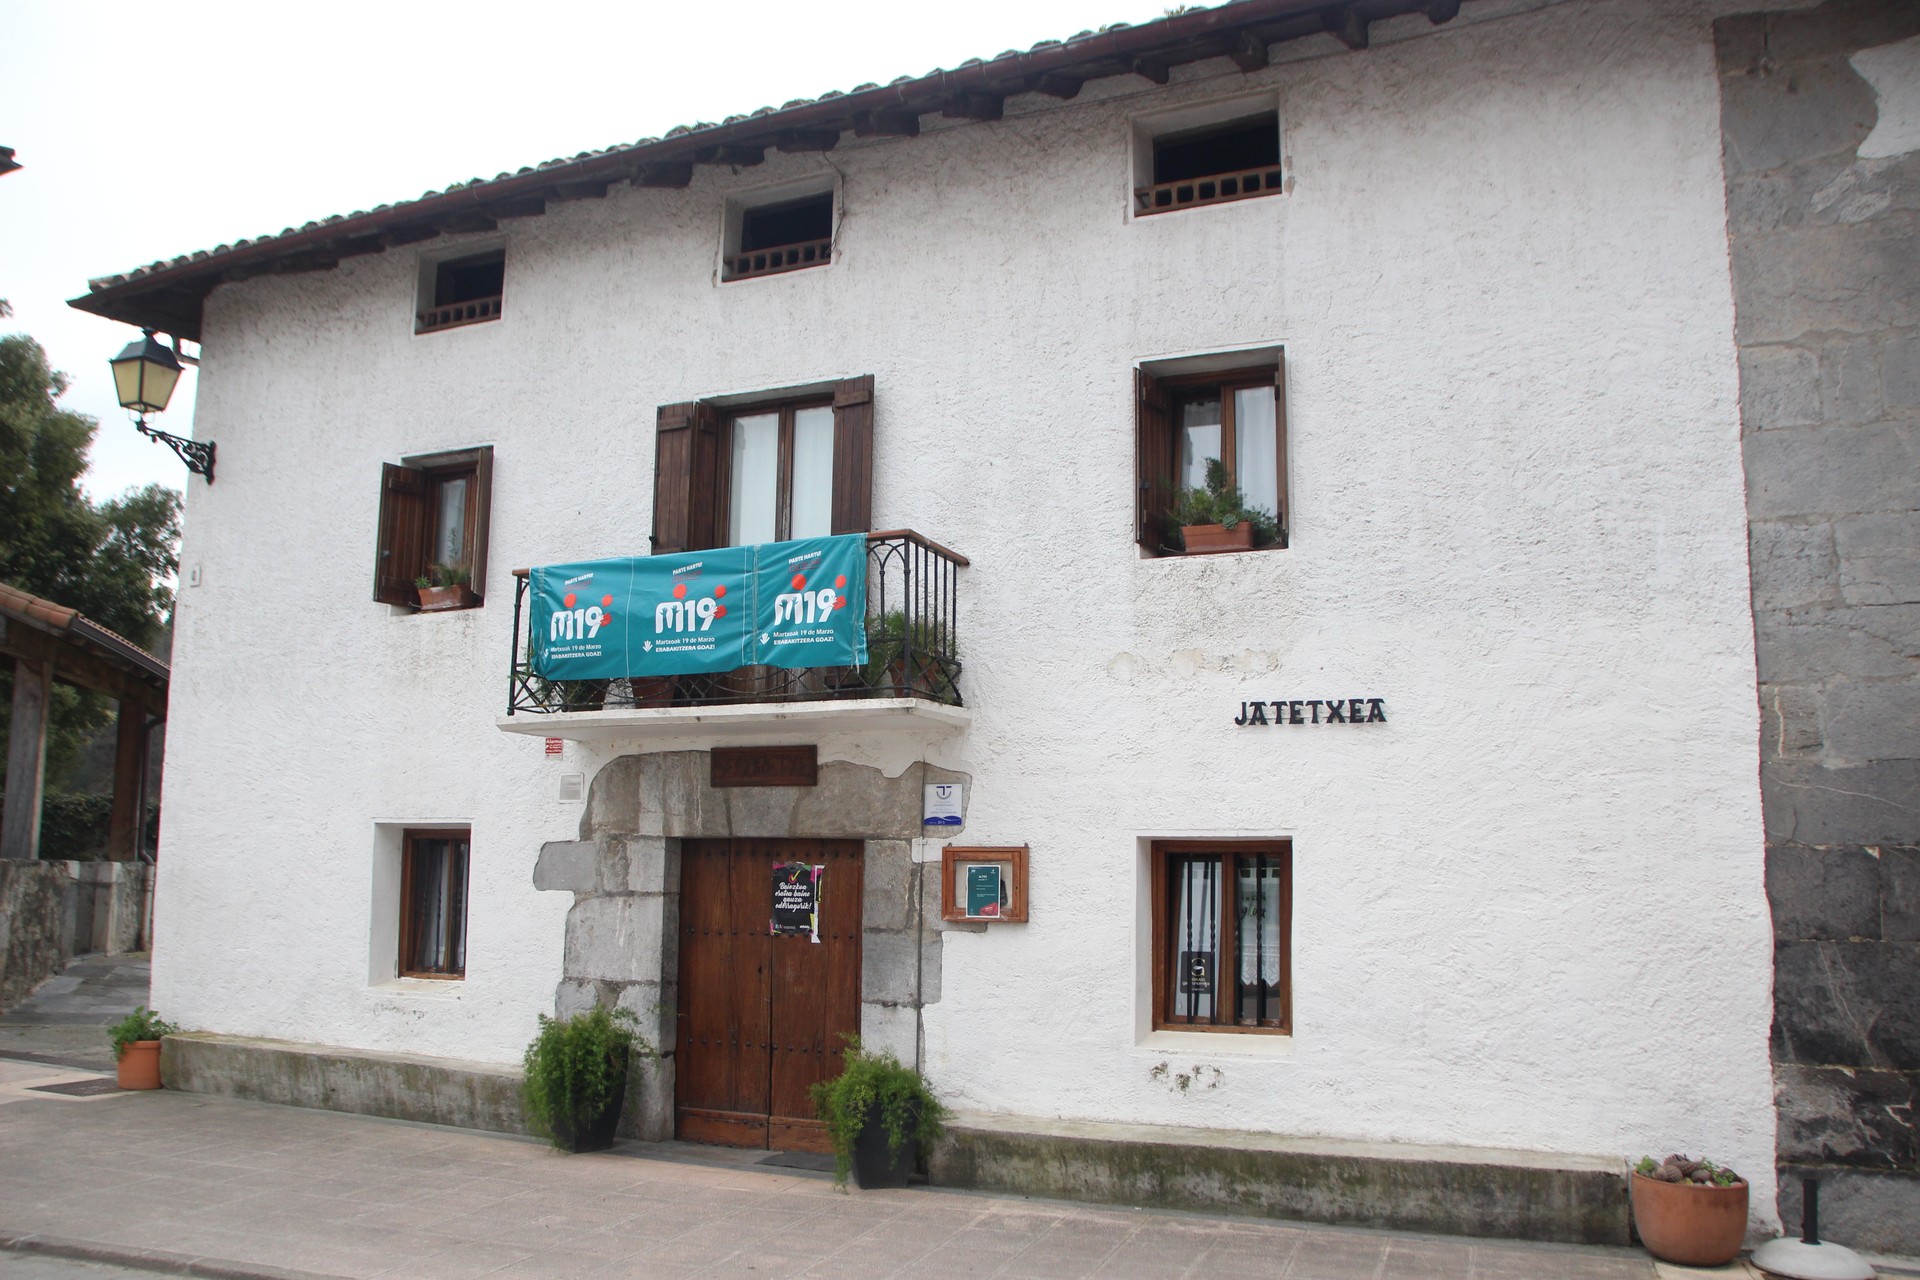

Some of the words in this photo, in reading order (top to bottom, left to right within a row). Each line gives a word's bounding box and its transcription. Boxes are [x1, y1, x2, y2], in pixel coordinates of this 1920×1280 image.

[789, 555, 803, 564] PARTE
[672, 567, 686, 575] PARTE
[564, 577, 577, 585] PARTE
[1234, 698, 1388, 726] JATETXEA
